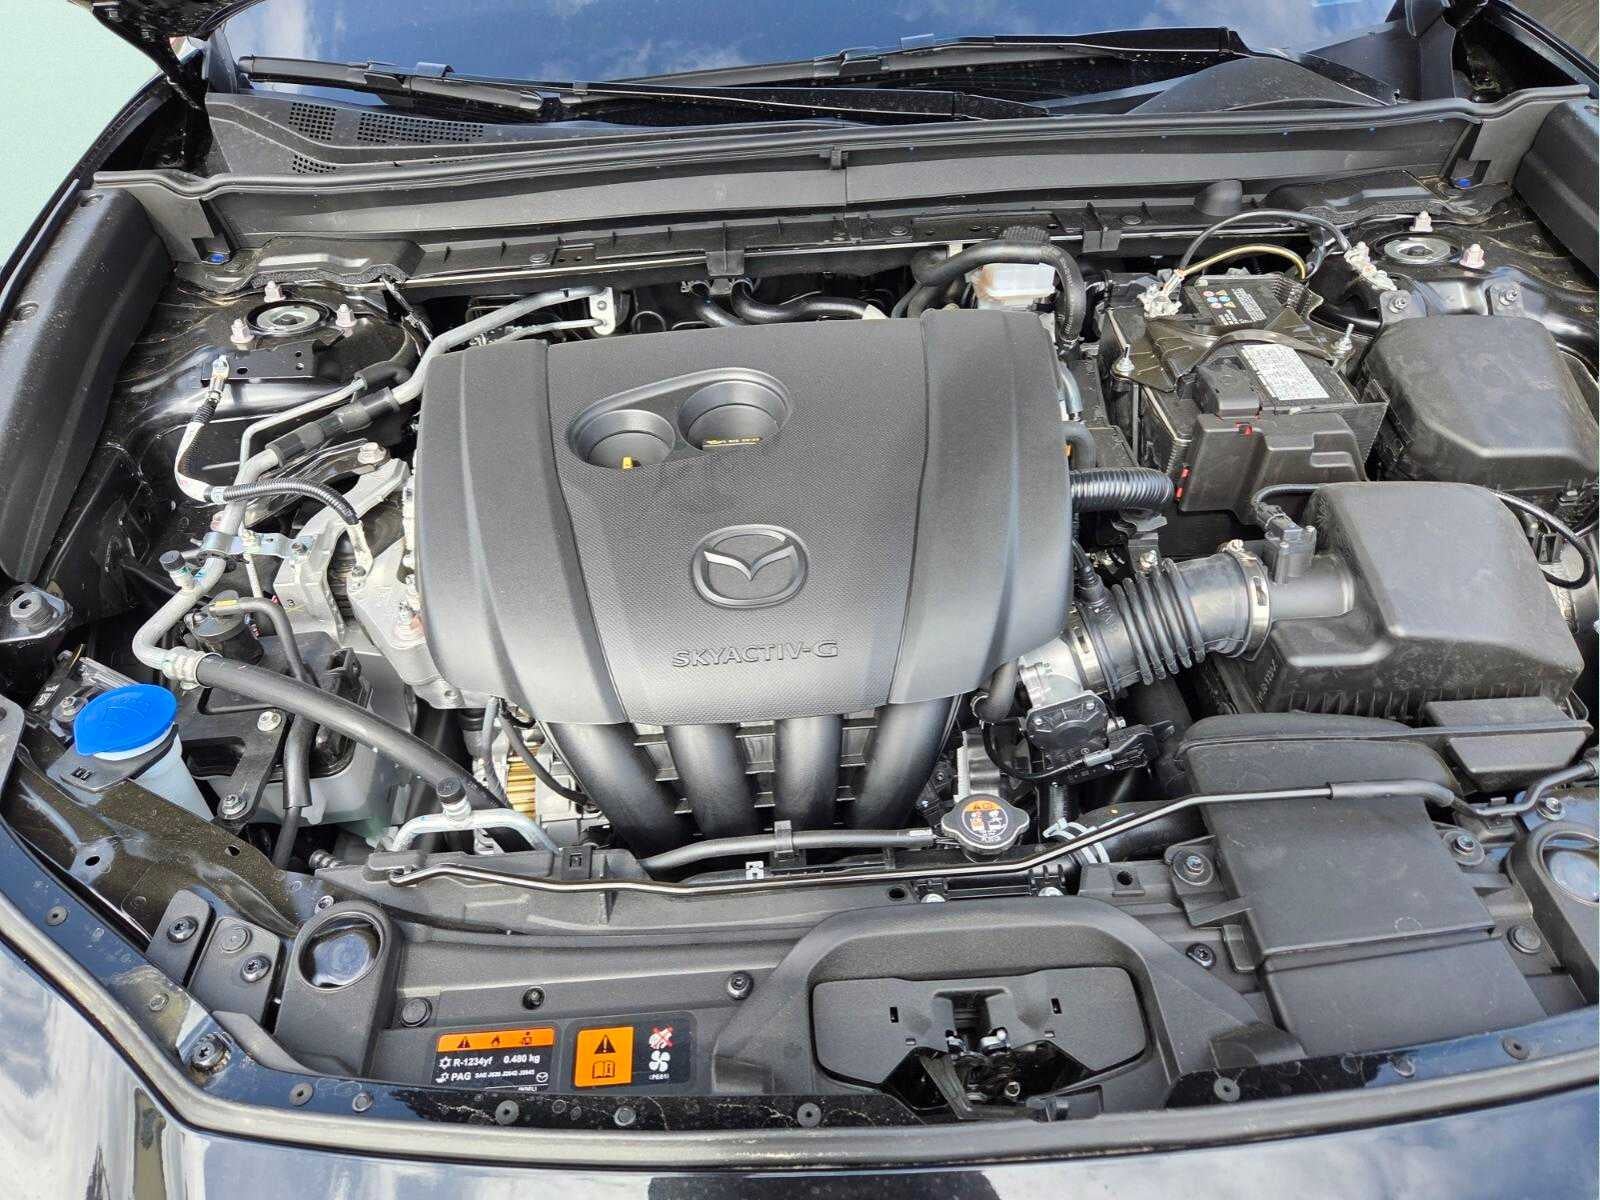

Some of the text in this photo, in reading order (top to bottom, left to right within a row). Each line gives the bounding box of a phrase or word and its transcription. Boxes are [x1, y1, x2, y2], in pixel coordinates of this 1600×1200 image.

[672, 640, 839, 668] SKYACTIV-G
[453, 1056, 493, 1067] R-1234yf
[529, 1053, 541, 1064] kg
[451, 1072, 472, 1082] PAG
